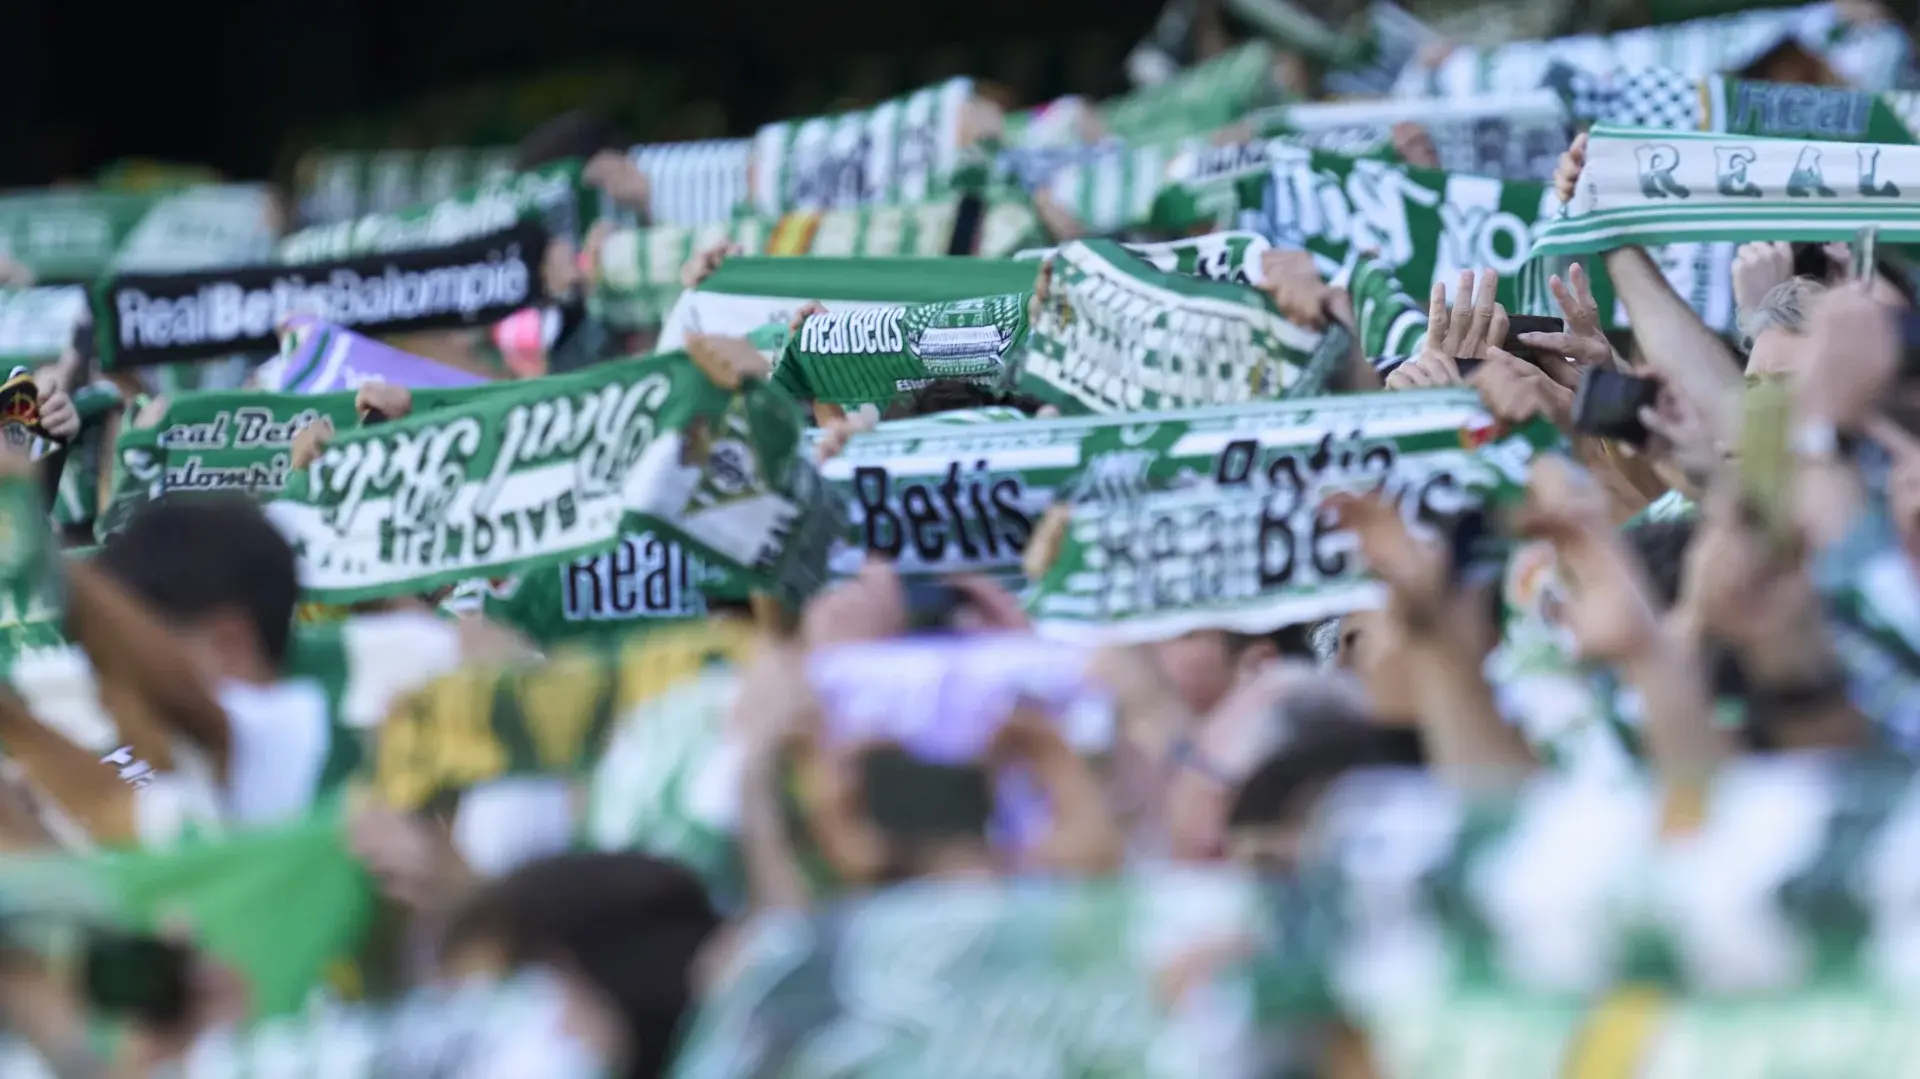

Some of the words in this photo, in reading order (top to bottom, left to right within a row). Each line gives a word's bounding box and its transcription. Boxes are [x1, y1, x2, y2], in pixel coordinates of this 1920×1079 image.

[1633, 143, 1901, 199] REAL
[158, 413, 228, 446] eal
[854, 457, 1034, 562] Betis
